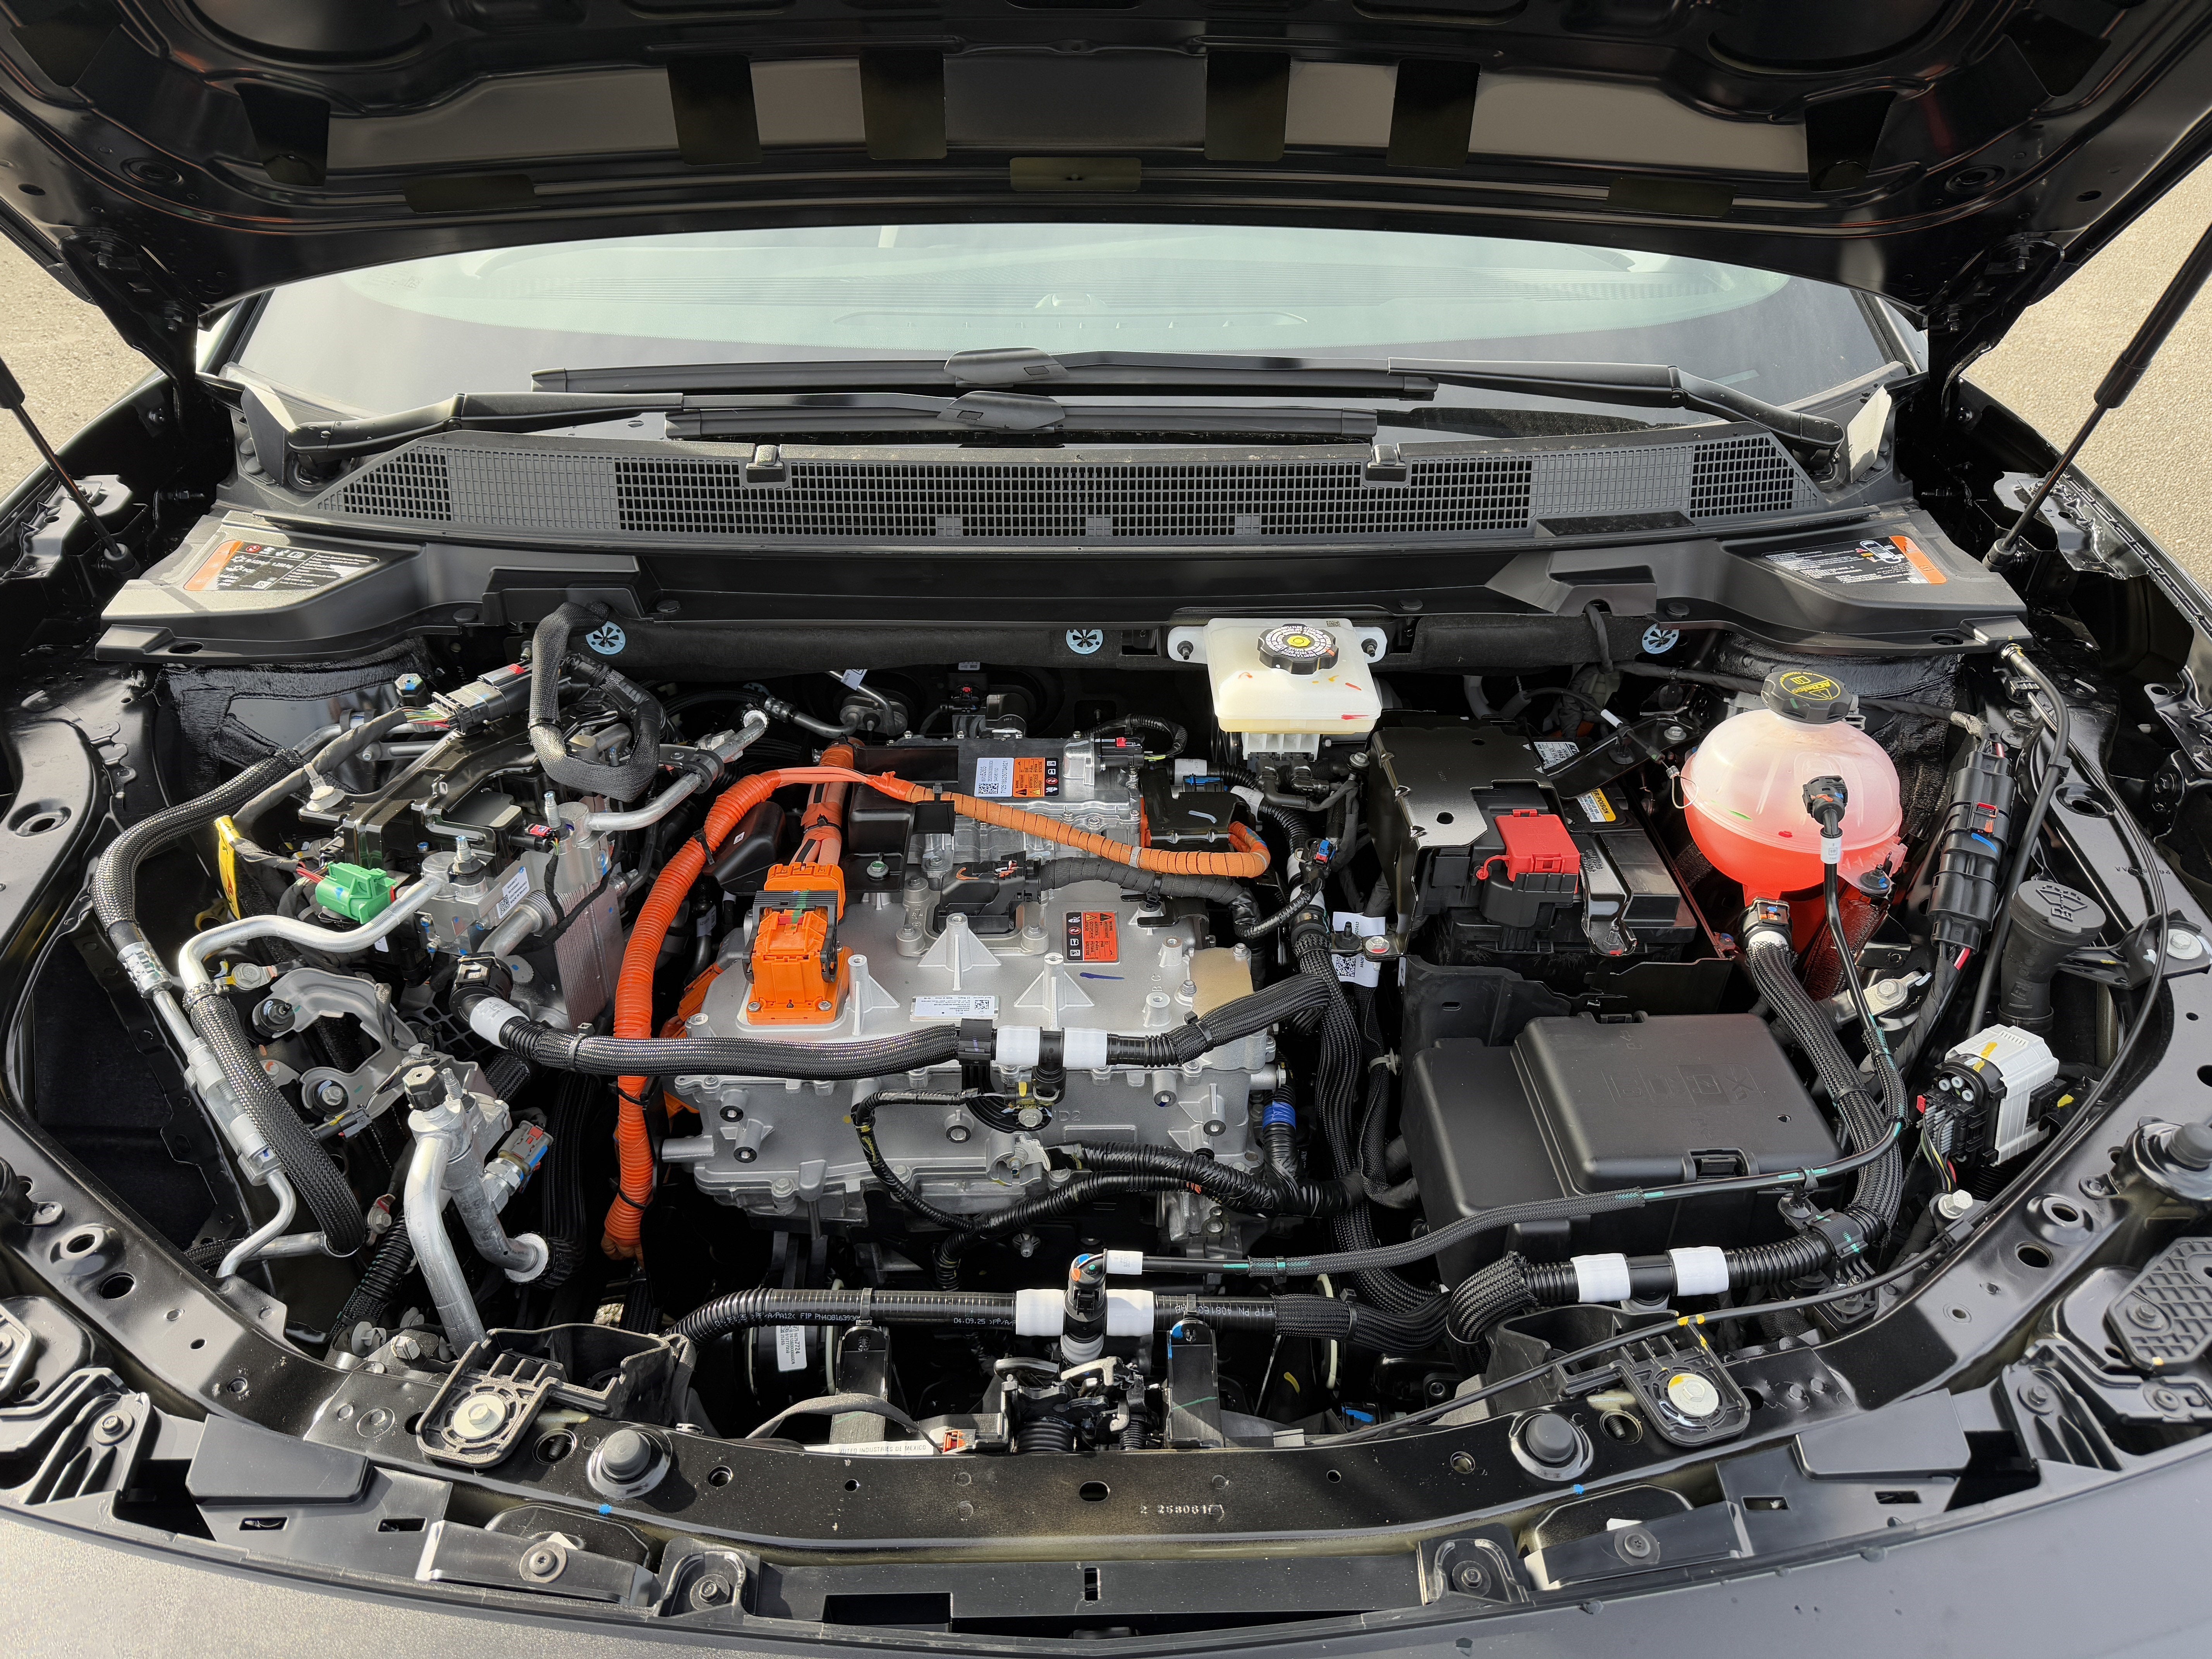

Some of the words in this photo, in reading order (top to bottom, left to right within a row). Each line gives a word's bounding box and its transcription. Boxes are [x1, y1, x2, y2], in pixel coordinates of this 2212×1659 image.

[1791, 681, 1831, 694] ACDelco
[1592, 789, 1610, 814] ER/POISON
[1175, 1305, 1231, 1315] 408163AB
[1238, 1307, 1249, 1316] PN
